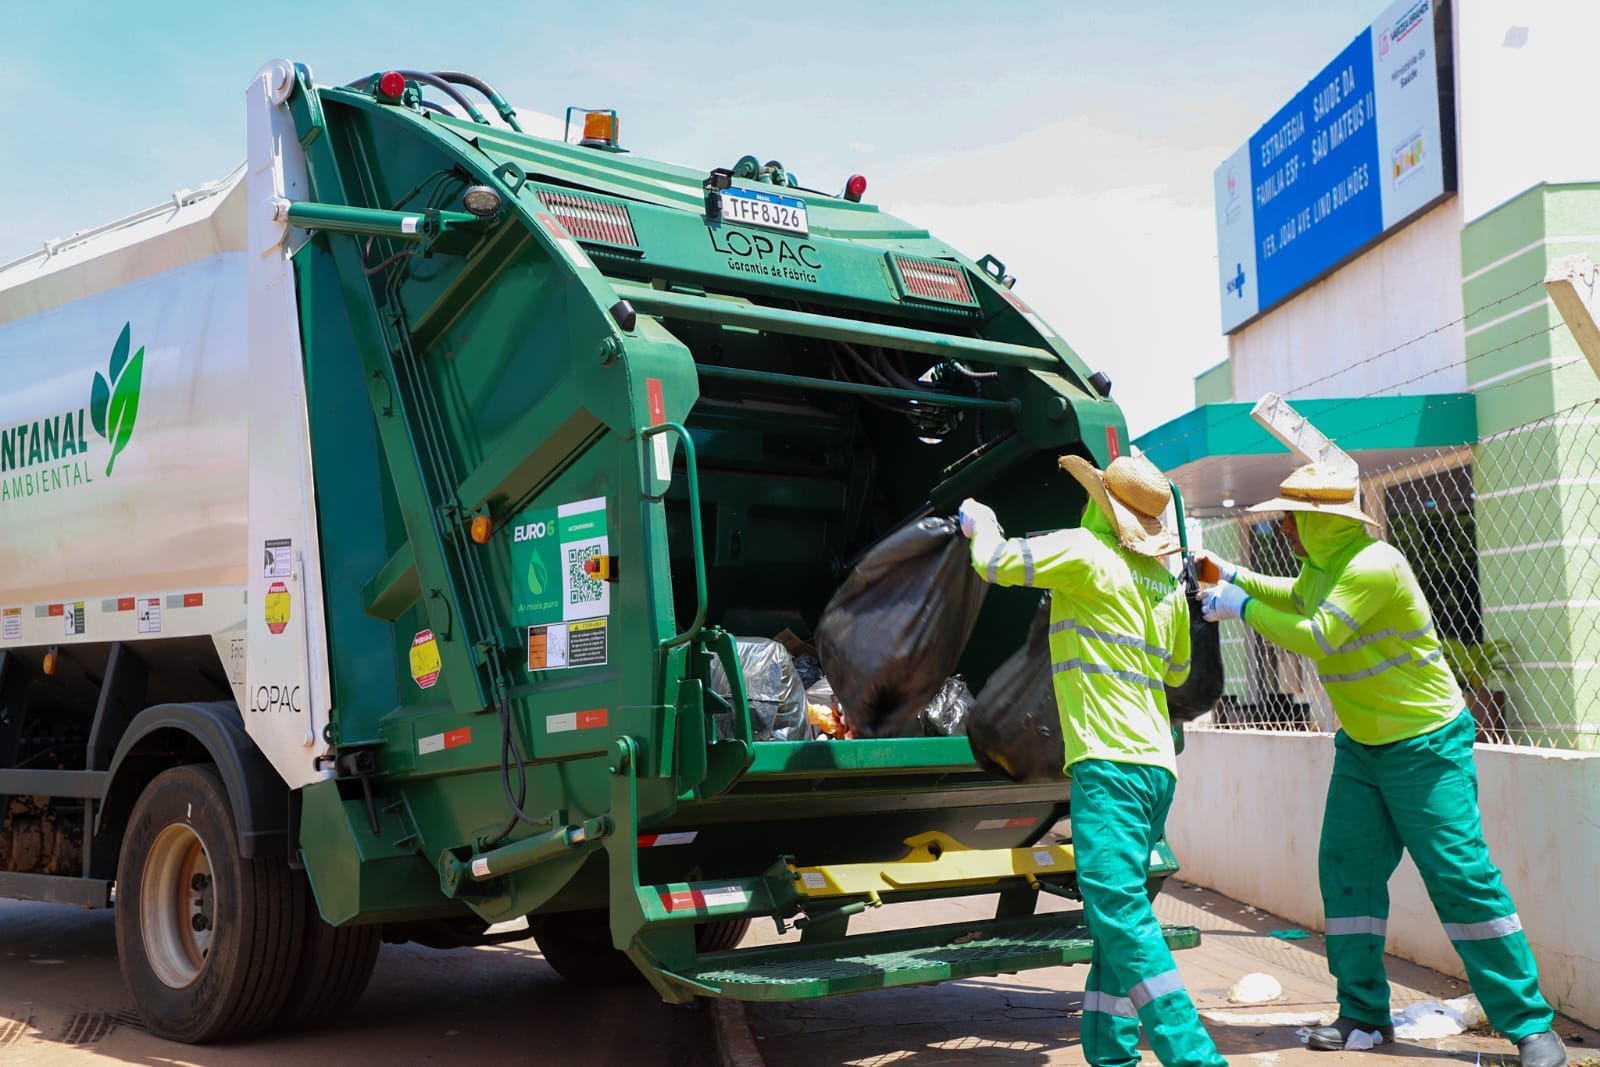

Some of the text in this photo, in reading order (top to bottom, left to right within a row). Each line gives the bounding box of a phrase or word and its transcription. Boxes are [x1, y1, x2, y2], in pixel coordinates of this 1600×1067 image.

[1313, 76, 1341, 123] SAUDE
[1342, 65, 1356, 97] DA
[1256, 168, 1285, 210] FAMILIA
[1285, 154, 1299, 188] ESF
[1312, 129, 1329, 165] SÃO
[1329, 98, 1365, 151] MATEUS
[730, 198, 800, 228] TFF8J26
[1313, 192, 1332, 224] LINO
[707, 226, 822, 270] LOPAC
[728, 257, 817, 283] Garantia de Fábrica
[2, 460, 93, 502] AMBIENTAL
[543, 600, 559, 611] puro
[250, 685, 302, 713] LOPAC
